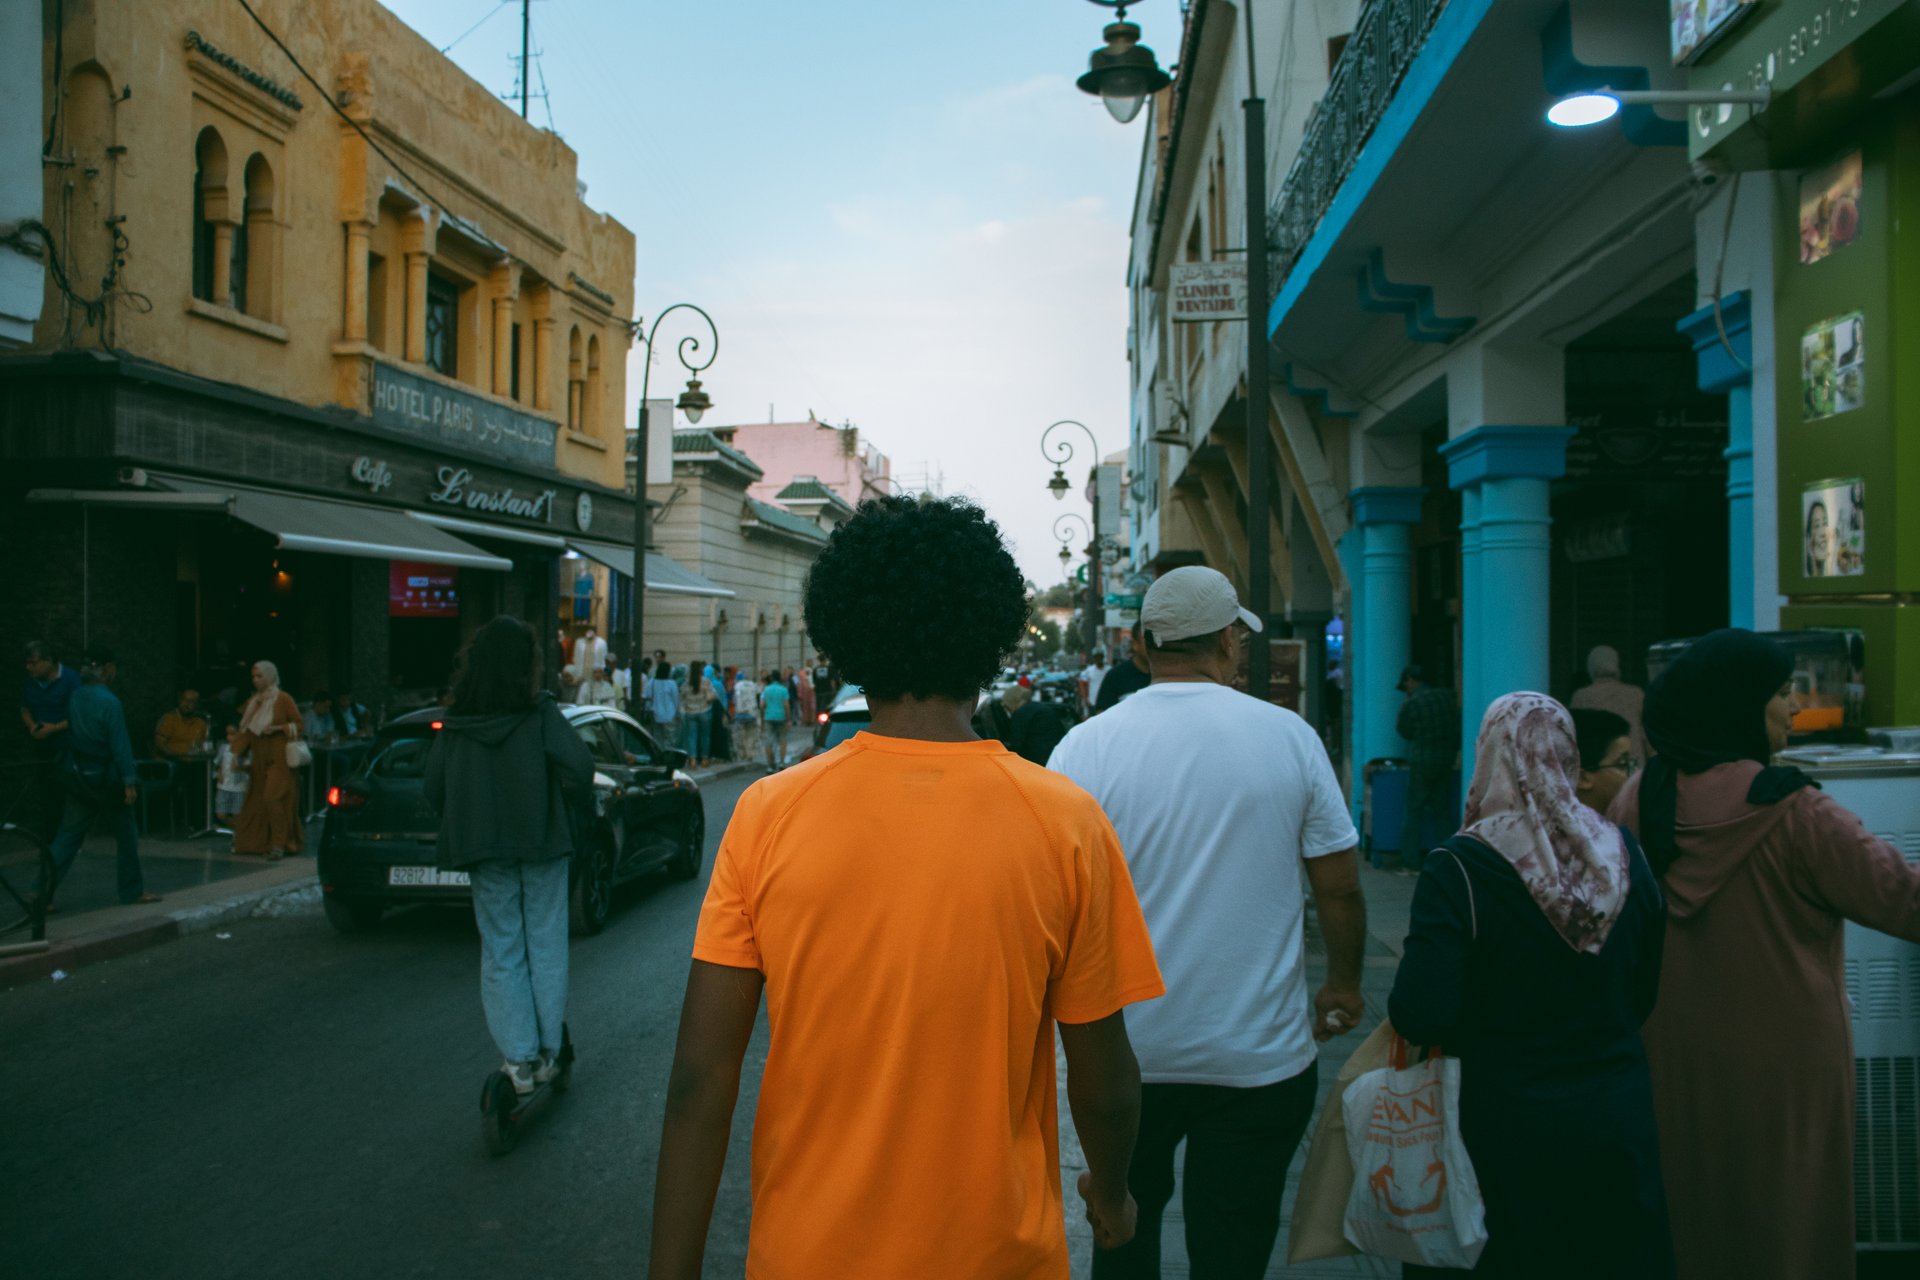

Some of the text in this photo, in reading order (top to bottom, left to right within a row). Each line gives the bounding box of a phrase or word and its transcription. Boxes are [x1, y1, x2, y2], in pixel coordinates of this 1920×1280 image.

[1176, 284, 1231, 298] CLINIQUE
[1176, 298, 1235, 312] DENTAIRE
[375, 380, 473, 432] HOTEL PARIS
